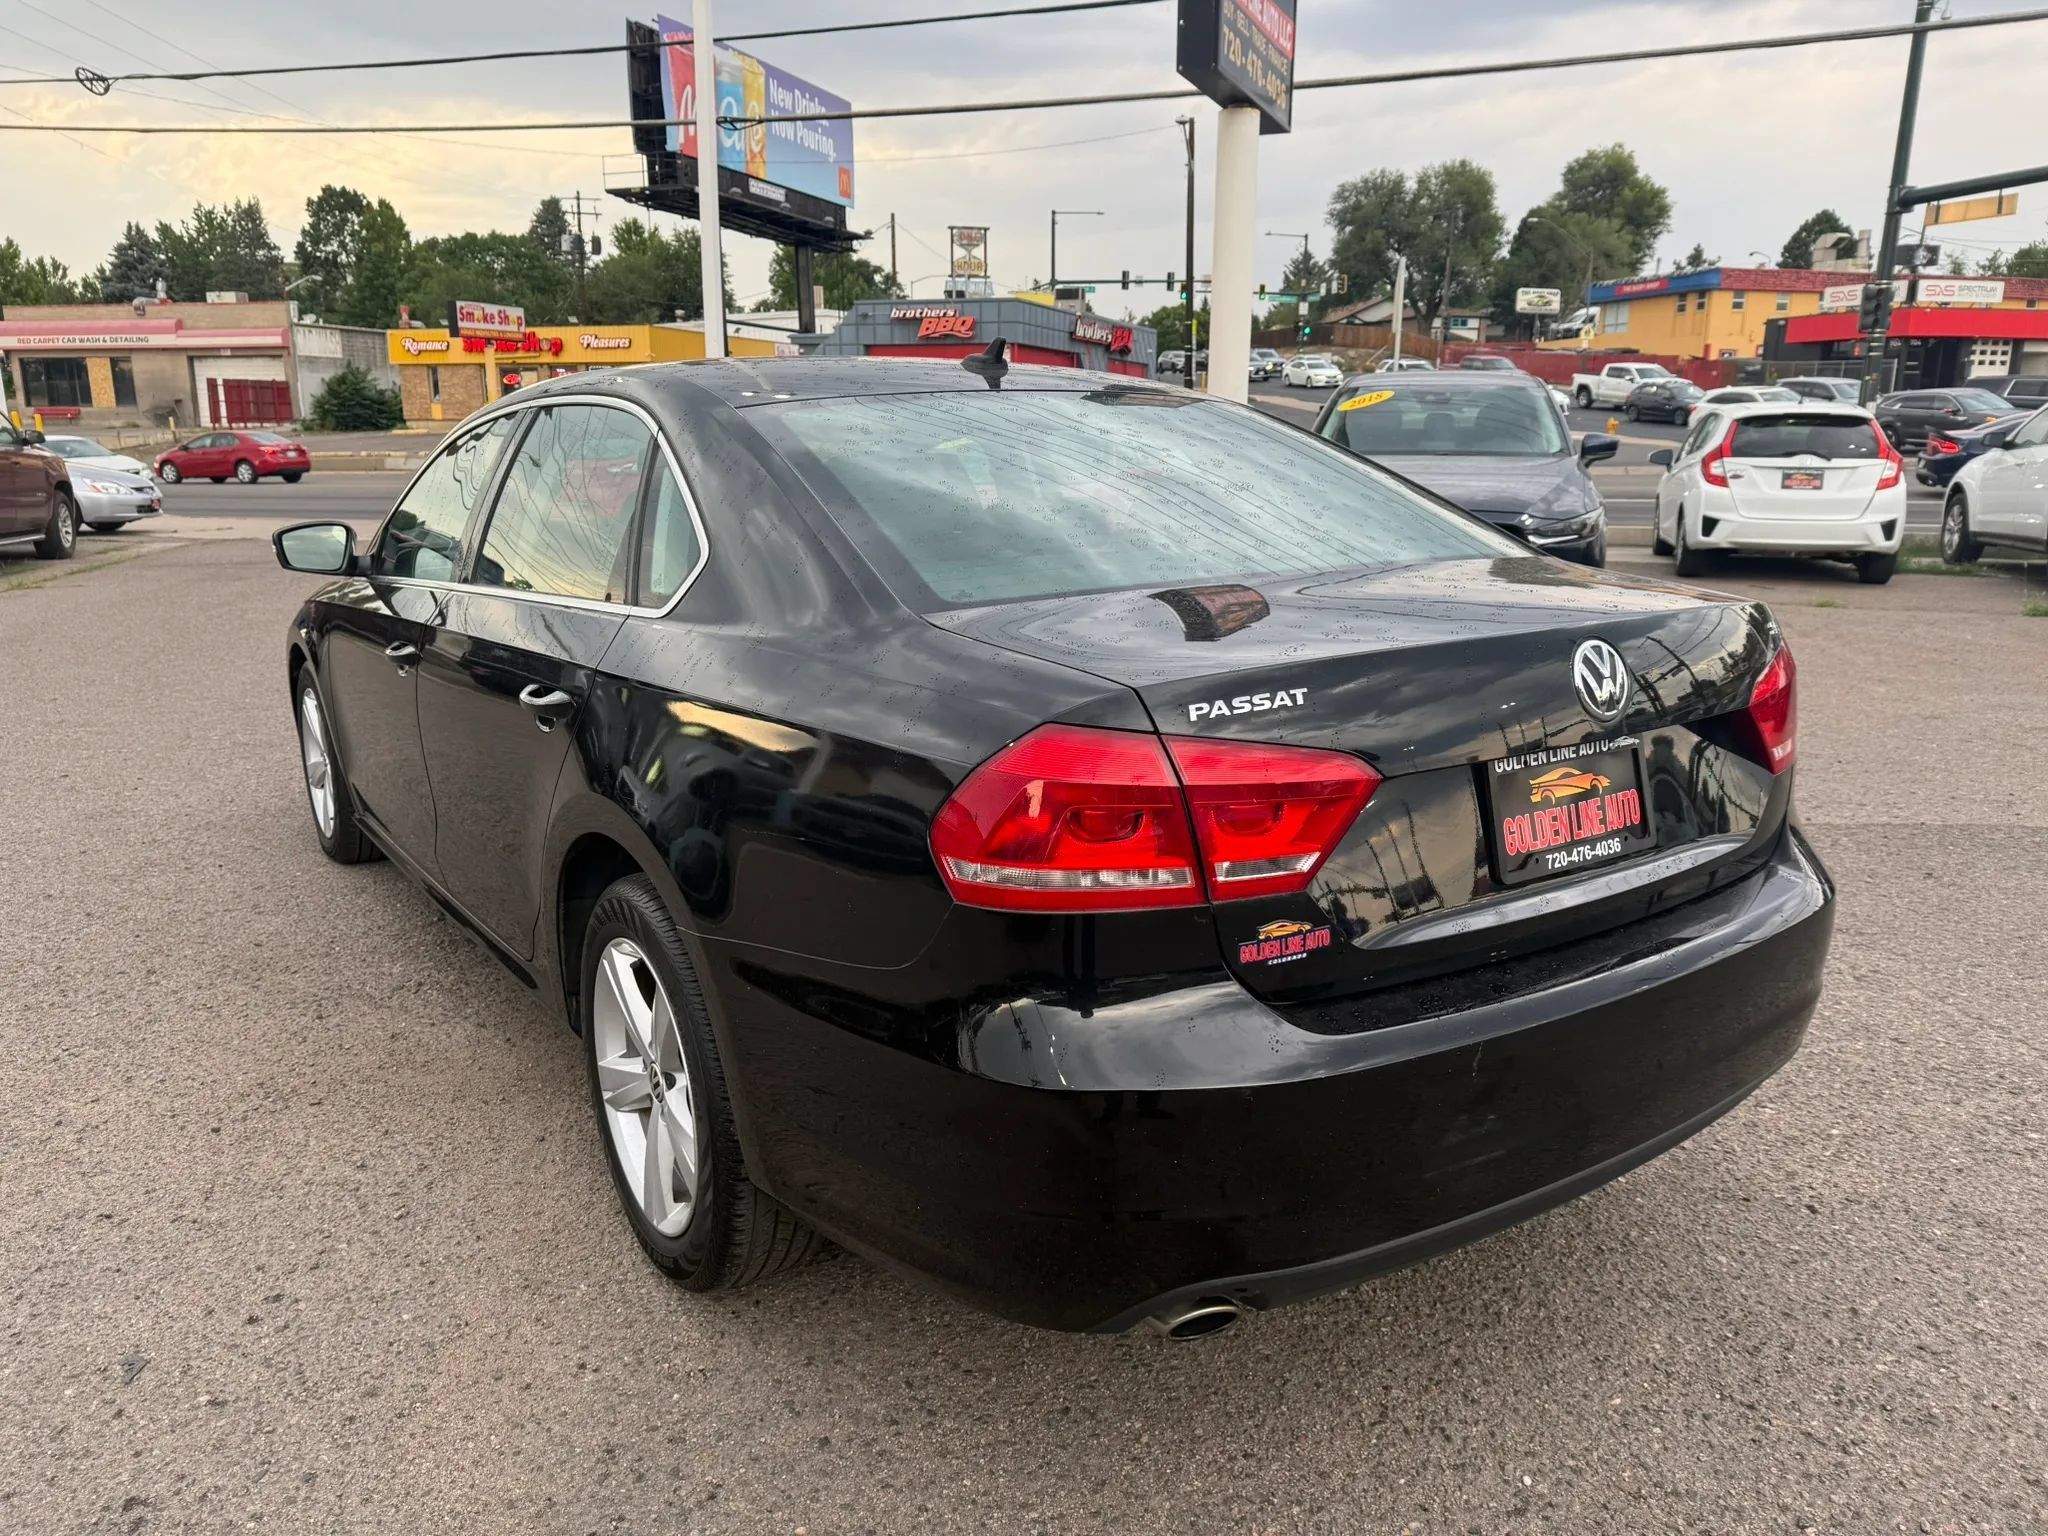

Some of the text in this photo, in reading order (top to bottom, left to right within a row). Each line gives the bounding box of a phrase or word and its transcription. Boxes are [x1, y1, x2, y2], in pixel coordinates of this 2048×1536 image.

[769, 77, 793, 111] New
[771, 109, 837, 163] Now Pouring.
[956, 261, 983, 272] HOUR
[1957, 284, 1998, 293] SPECTRUM
[458, 304, 495, 325] Smoke
[890, 306, 955, 319] brothers
[918, 316, 976, 338] BBQ
[1075, 318, 1113, 343] brothers
[17, 337, 31, 345] RED
[33, 337, 60, 345] CARPET
[61, 336, 76, 344] CAR
[78, 336, 100, 344] WASH
[109, 335, 149, 344] DETAILING
[401, 337, 449, 355] Romance
[580, 333, 631, 350] Pleasures
[1349, 392, 1384, 408] 2018
[1188, 687, 1308, 722] PASSAT
[1494, 739, 1609, 773] GOLDEN LINE AUTO
[1503, 788, 1641, 856] GOLDEN LINE AUTO
[1545, 837, 1622, 870] 720-476-4036
[1240, 928, 1331, 963] GOLDEN LINE AUTO
[1267, 953, 1308, 966] COLORADO
